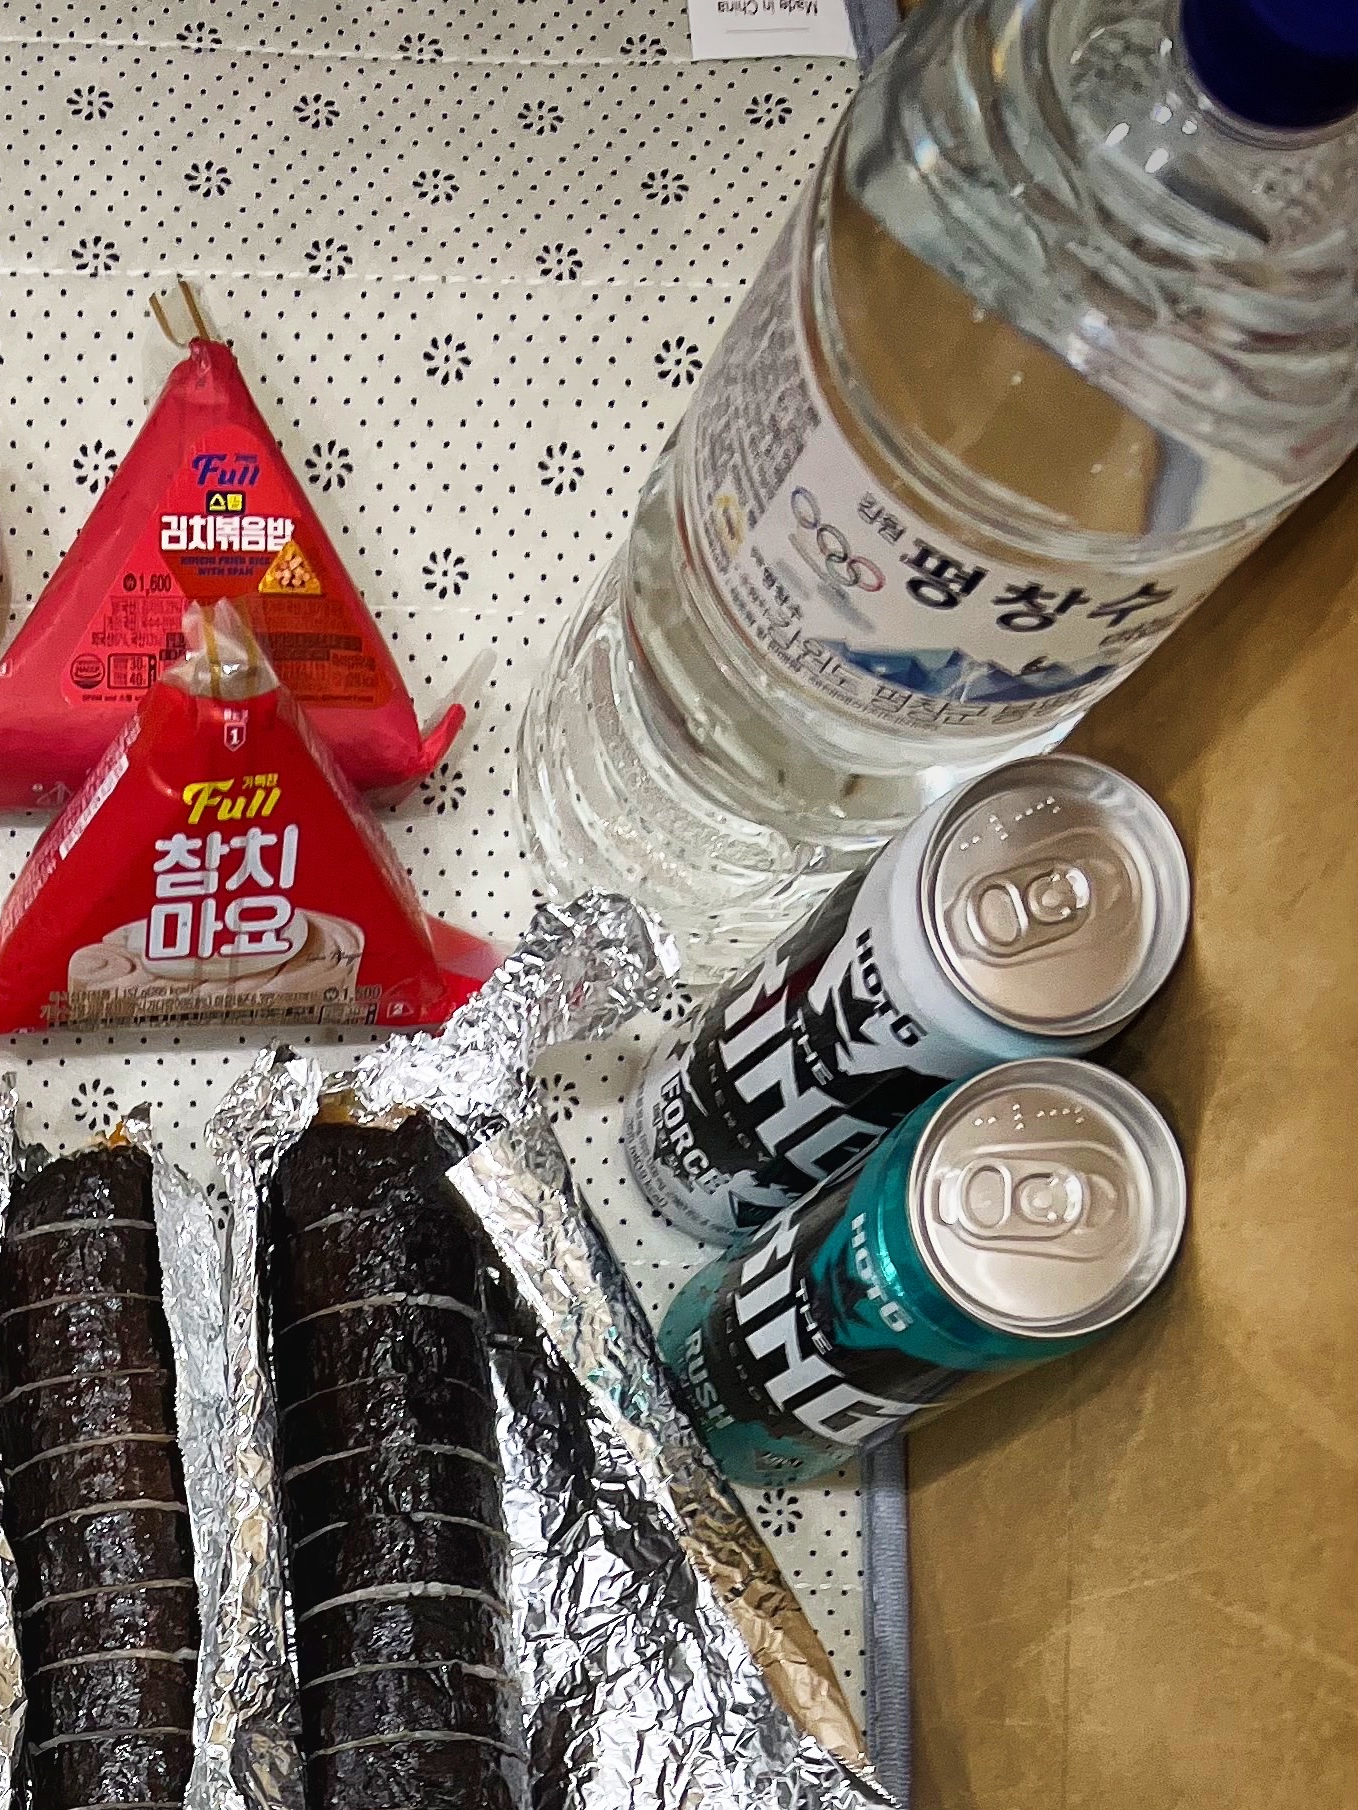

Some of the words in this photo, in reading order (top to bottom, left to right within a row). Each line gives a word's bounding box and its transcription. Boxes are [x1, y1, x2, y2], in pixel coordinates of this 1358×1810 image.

[717, 0, 759, 16] China
[192, 453, 260, 487] Full
[161, 515, 294, 552] 김치볶음밥
[899, 537, 1180, 634] 평창수
[230, 729, 241, 746] 1
[183, 777, 282, 824] Full
[153, 823, 299, 899] 참치
[147, 894, 294, 960] 마요
[792, 1007, 835, 1086] THE
[659, 1069, 731, 1197] FORCE
[734, 1182, 942, 1446] KING
[795, 1277, 833, 1355] THE
[684, 1327, 736, 1430] RUSH
